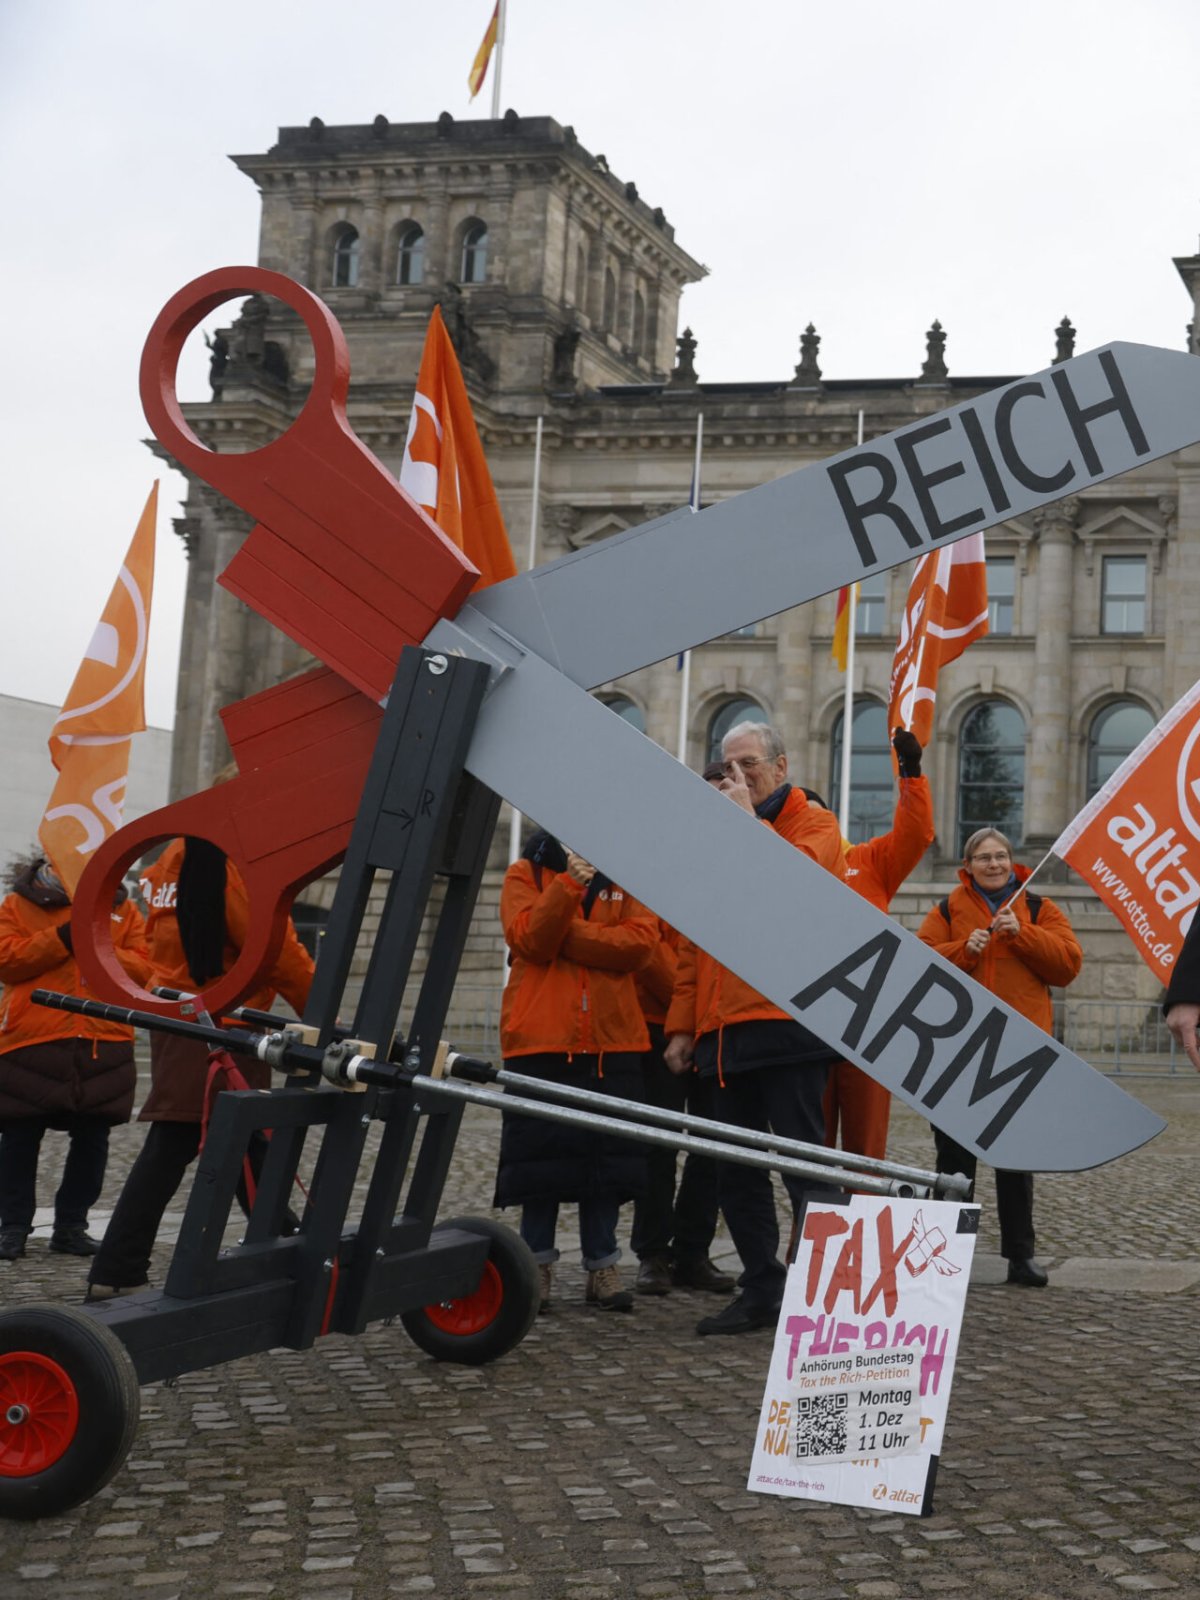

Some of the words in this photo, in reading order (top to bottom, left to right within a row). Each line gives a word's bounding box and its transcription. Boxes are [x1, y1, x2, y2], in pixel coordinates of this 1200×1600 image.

[827, 350, 1151, 568] REICH
[1091, 857, 1174, 967] www.attac.de
[790, 929, 1060, 1151] ARM
[803, 1205, 915, 1318] TAX
[800, 1358, 853, 1374] Anhörung
[855, 1352, 914, 1367] Bundestag
[800, 1376, 817, 1388] Tax
[820, 1375, 836, 1386] the
[839, 1368, 910, 1384] Rich-Petition
[858, 1390, 912, 1406] Montag
[859, 1413, 872, 1429] 1.
[876, 1411, 903, 1427] Dez
[858, 1434, 876, 1451] 11
[882, 1432, 910, 1449] Uhr
[756, 1474, 825, 1491] attac.de/tax-the-rich
[889, 1489, 922, 1504] attac
